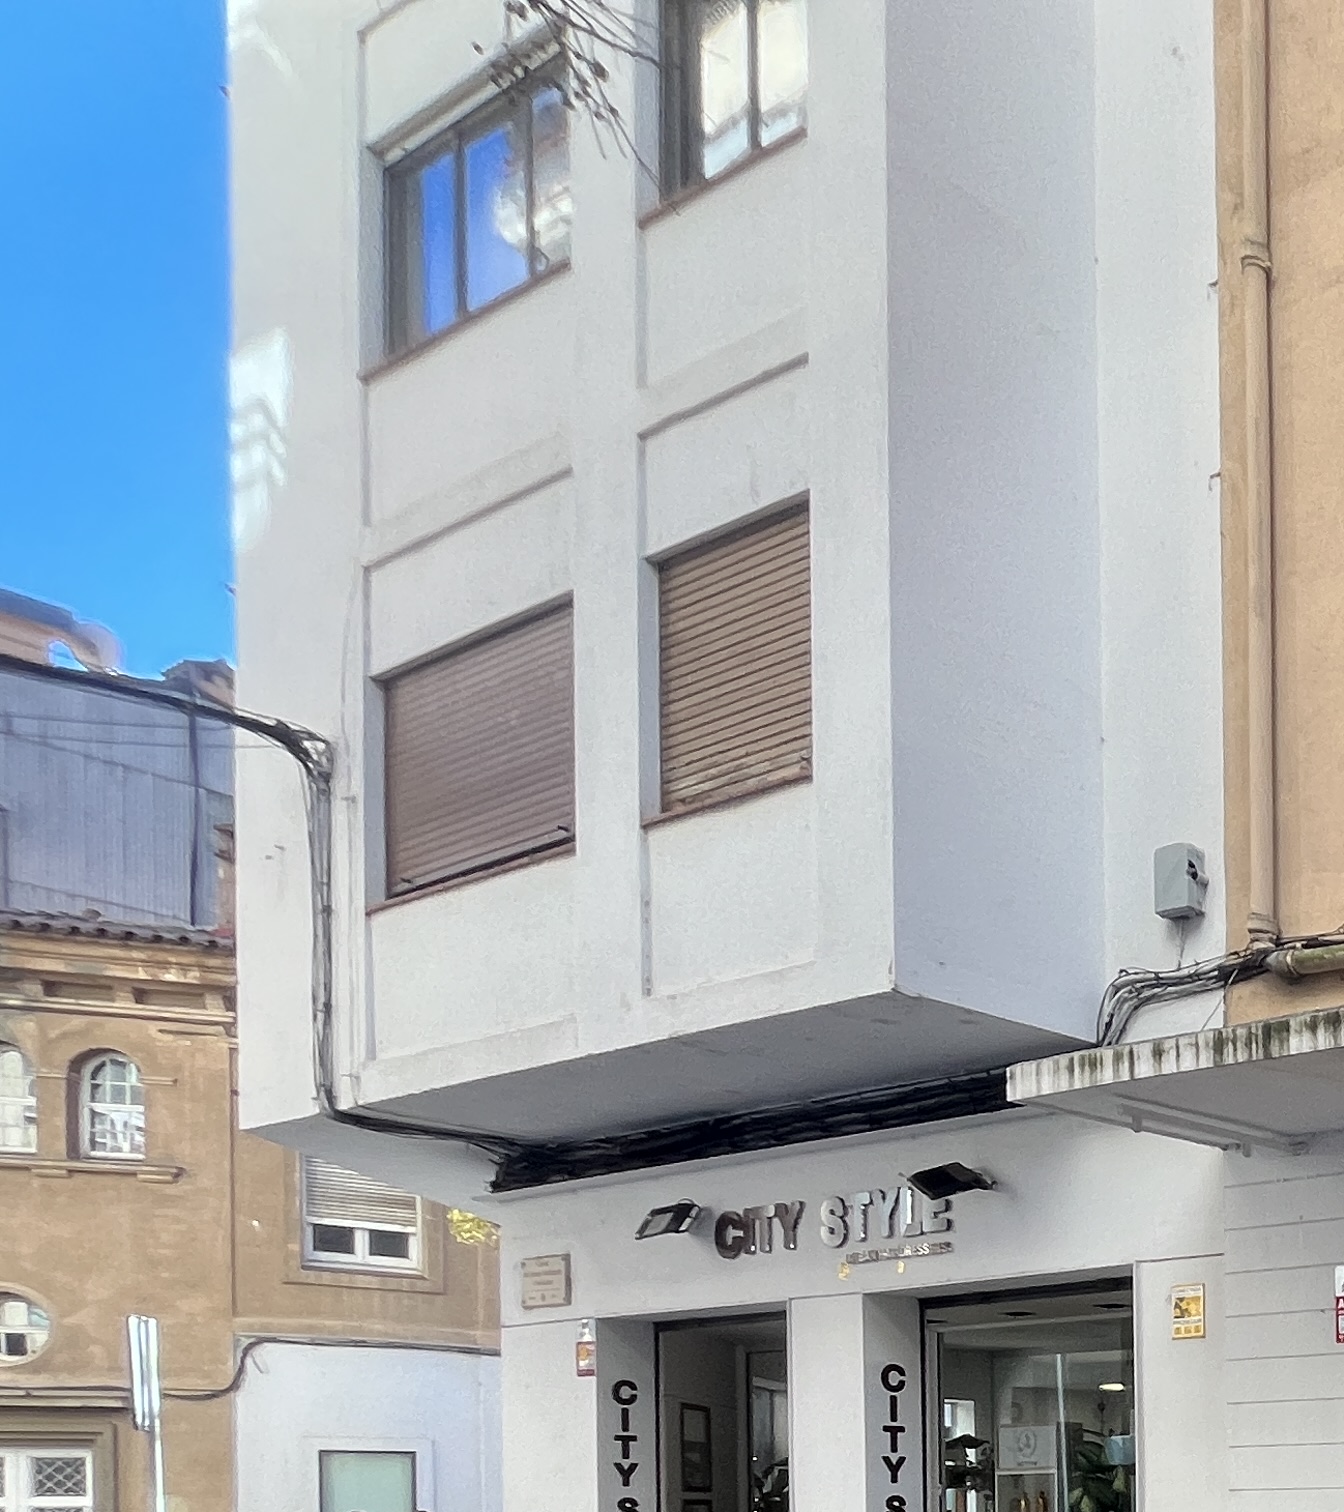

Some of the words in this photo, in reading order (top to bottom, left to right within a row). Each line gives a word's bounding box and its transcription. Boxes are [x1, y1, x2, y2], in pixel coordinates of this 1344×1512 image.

[714, 1200, 806, 1259] CITY
[820, 1186, 954, 1249] STYLE
[611, 1379, 639, 1487] CITY
[881, 1363, 907, 1484] CITY
